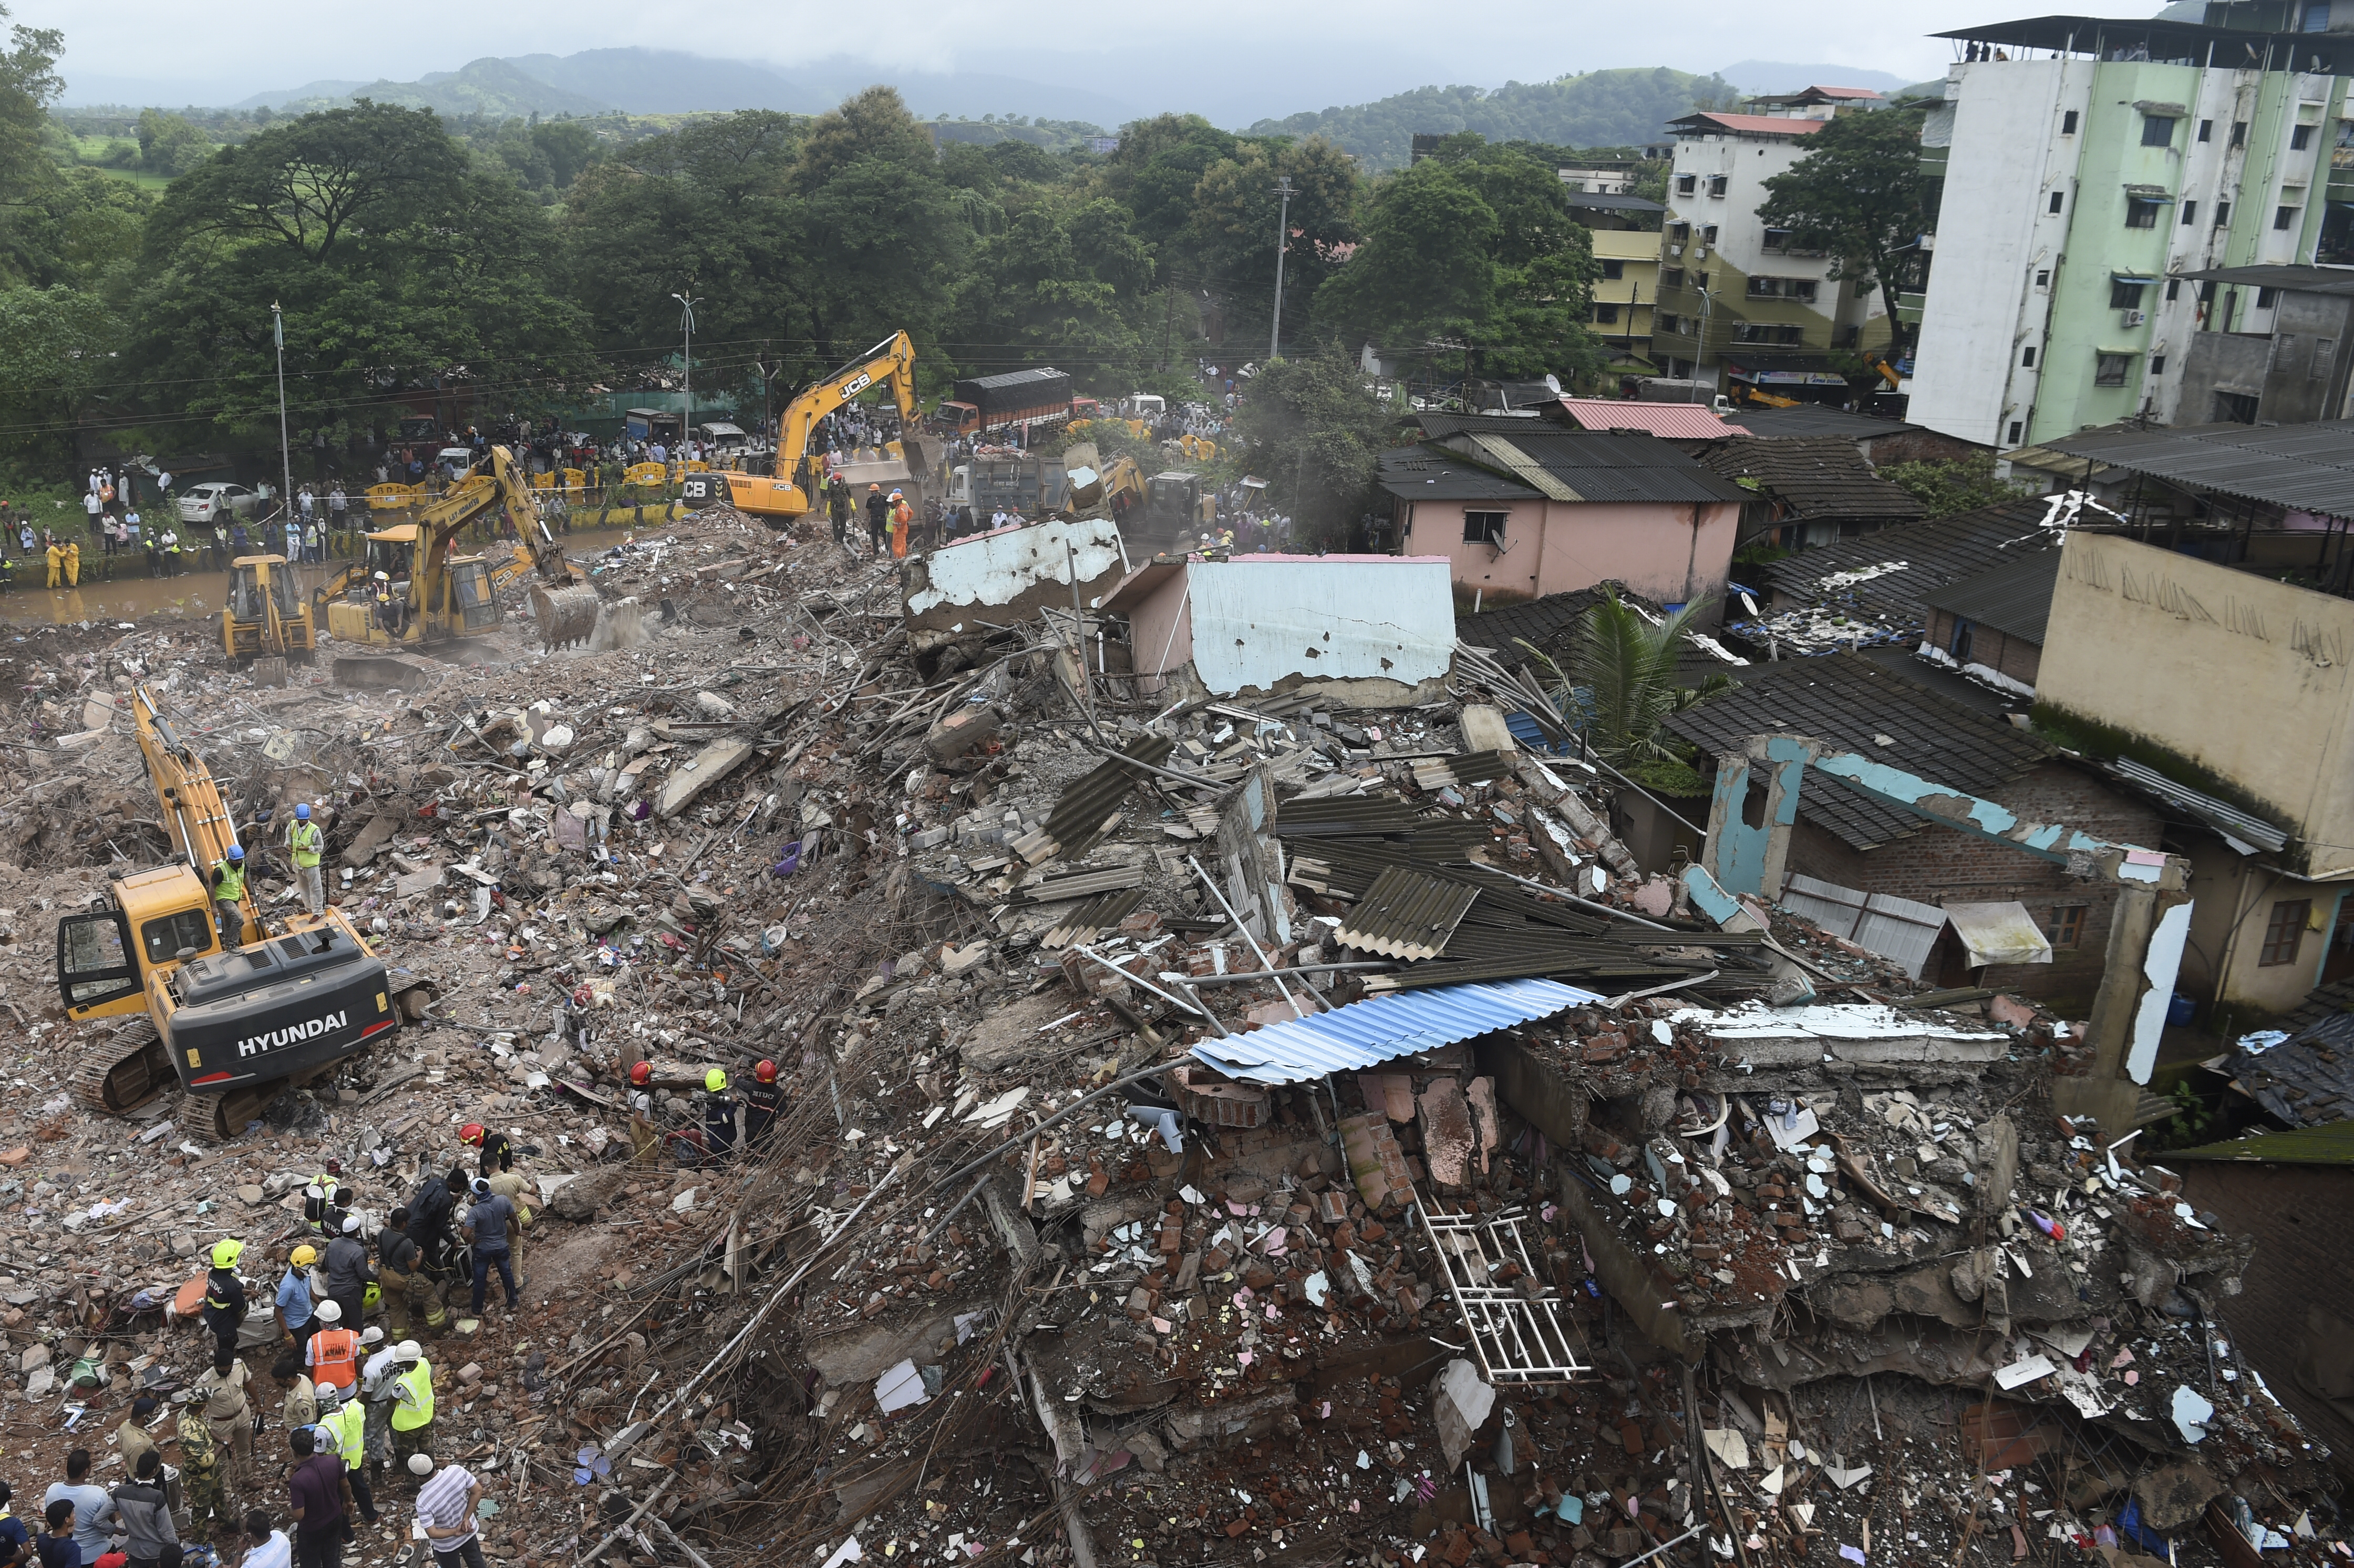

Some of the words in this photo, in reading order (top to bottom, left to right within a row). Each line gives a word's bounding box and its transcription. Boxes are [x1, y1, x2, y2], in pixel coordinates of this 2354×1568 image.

[841, 373, 871, 399] JCB
[448, 496, 480, 522] L&T-KOMATSU
[238, 1010, 347, 1057] HYUNDAI
[752, 1090, 775, 1100] MIDC
